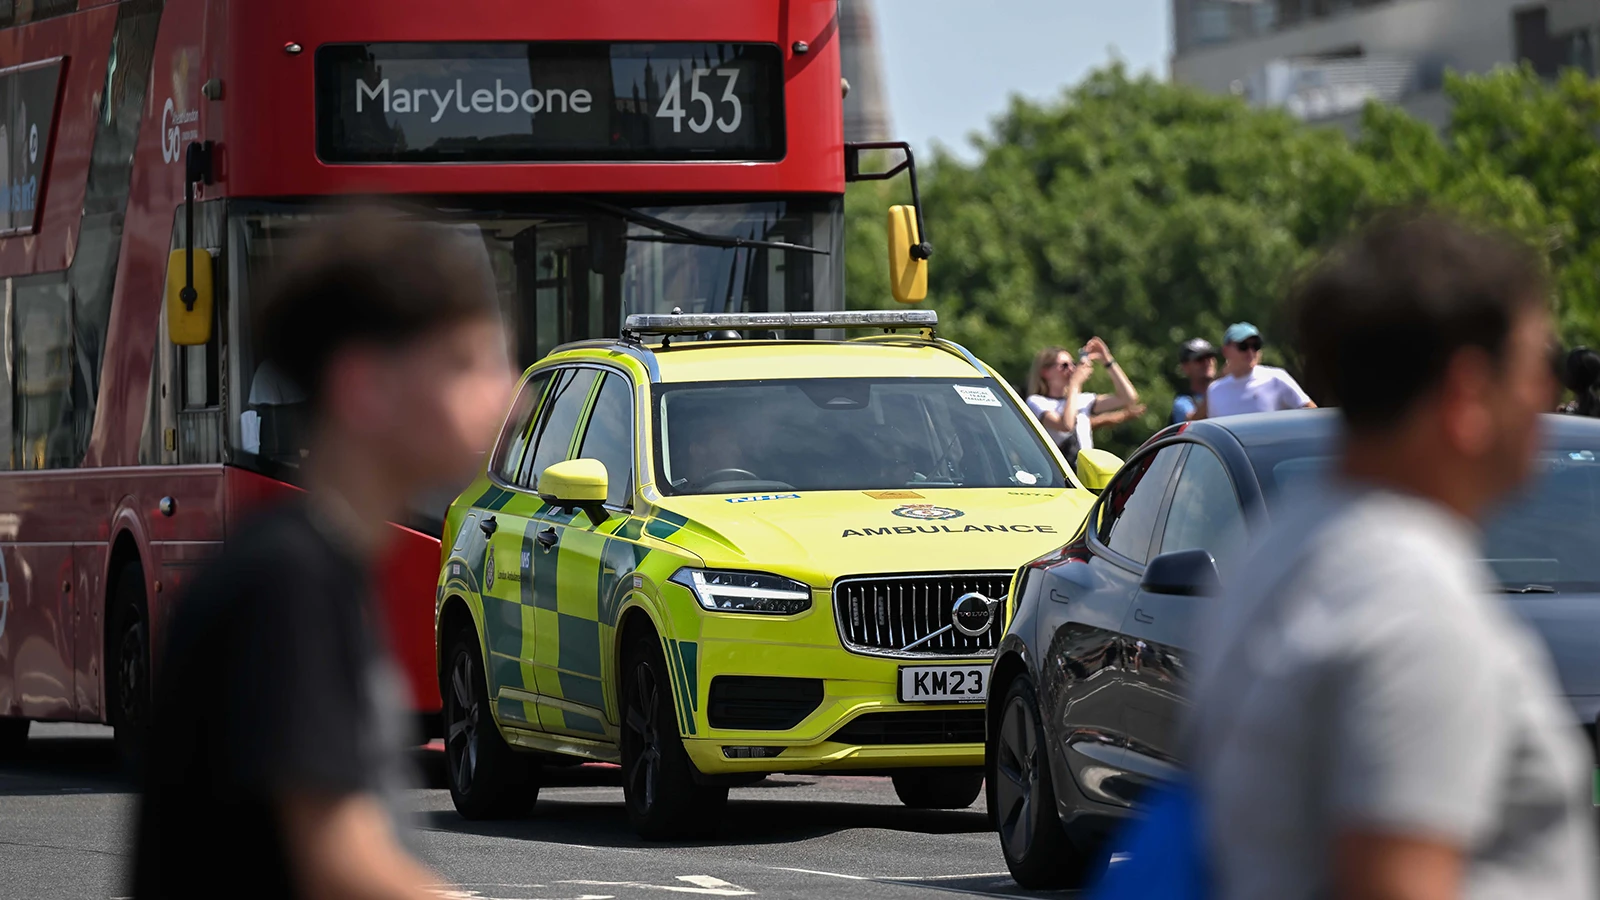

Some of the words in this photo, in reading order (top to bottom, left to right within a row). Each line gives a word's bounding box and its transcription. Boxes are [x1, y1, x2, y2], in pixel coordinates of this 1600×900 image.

[356, 78, 593, 123] Marylebone
[655, 67, 743, 134] 453
[162, 97, 181, 165] Go
[729, 494, 797, 503] NHS
[842, 523, 1058, 538] AMBULANCE
[914, 670, 983, 695] KM23
